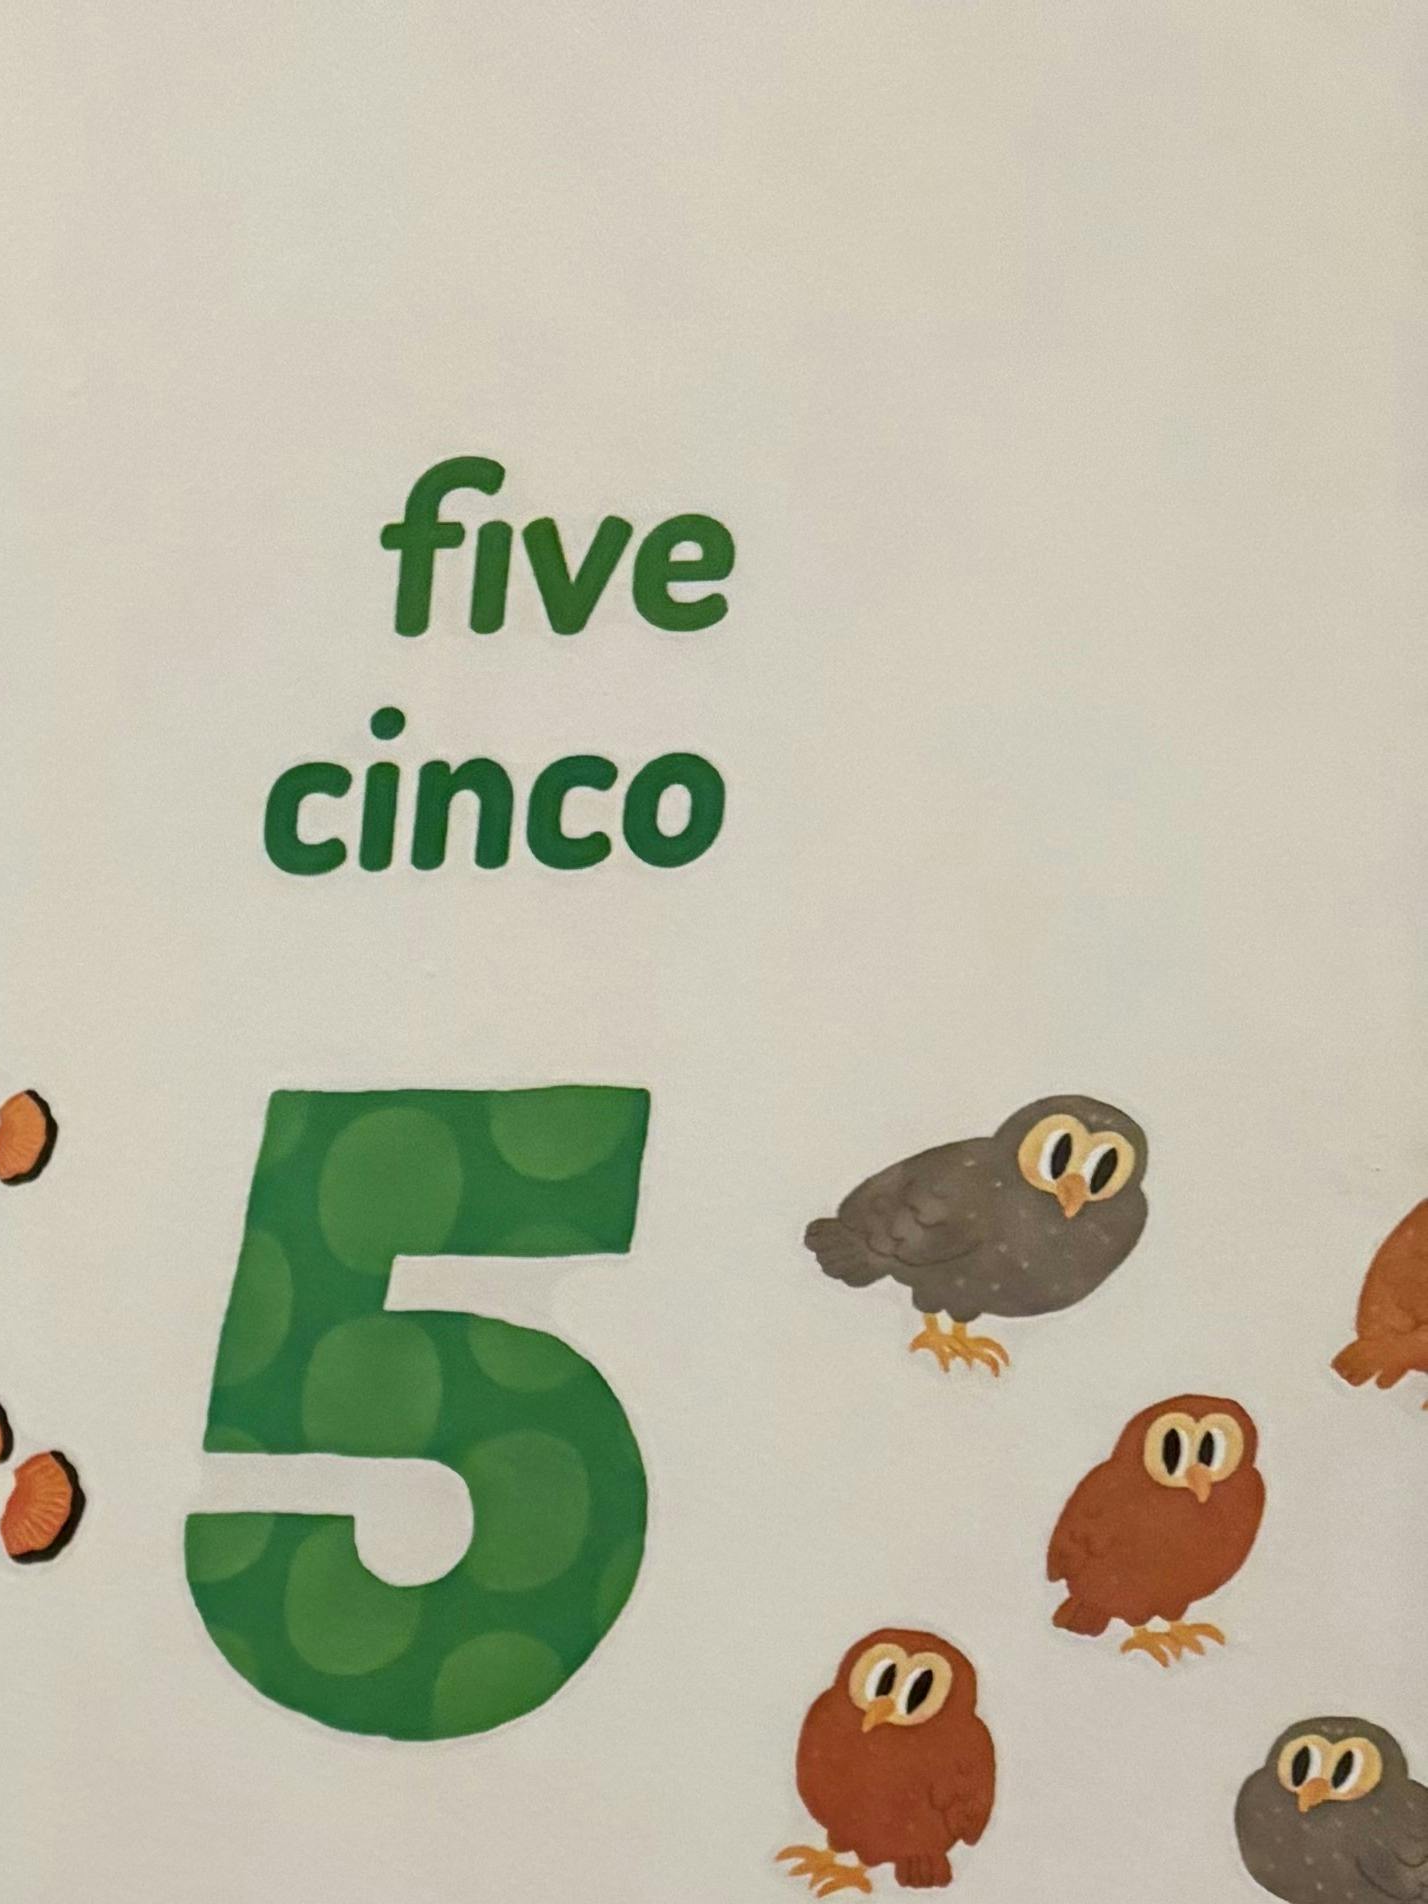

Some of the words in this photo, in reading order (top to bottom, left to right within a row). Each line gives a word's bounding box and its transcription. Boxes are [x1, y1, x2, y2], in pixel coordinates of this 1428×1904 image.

[380, 455, 735, 637] five
[263, 706, 726, 876] cinco
[183, 1083, 652, 1742] 5
